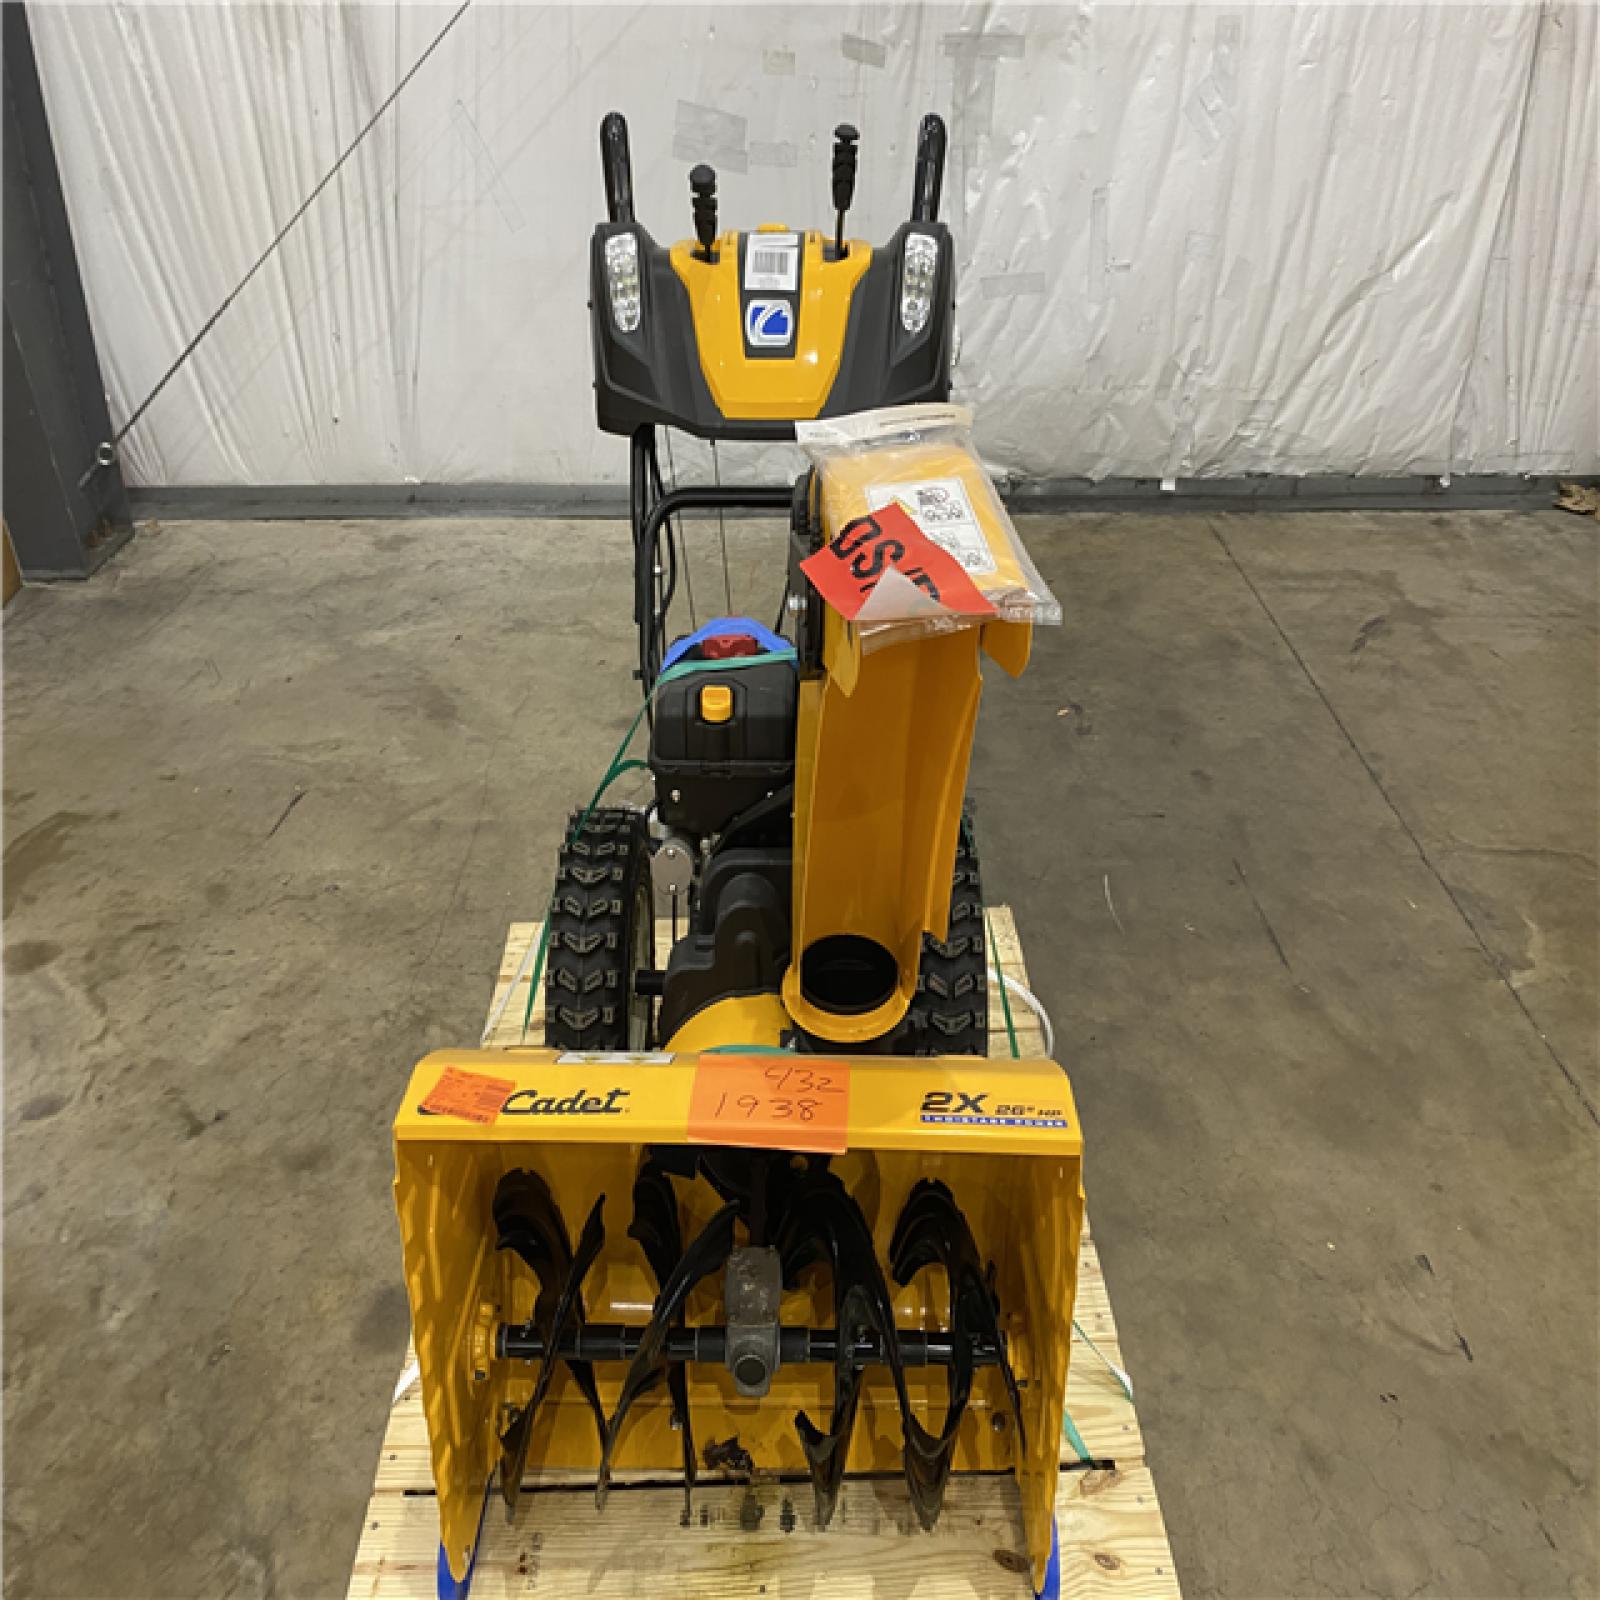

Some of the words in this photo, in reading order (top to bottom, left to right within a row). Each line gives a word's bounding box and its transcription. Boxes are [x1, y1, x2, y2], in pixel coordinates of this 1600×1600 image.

[502, 1088, 631, 1115] Cadet
[714, 1091, 823, 1121] 1938
[920, 1091, 989, 1113] 2X
